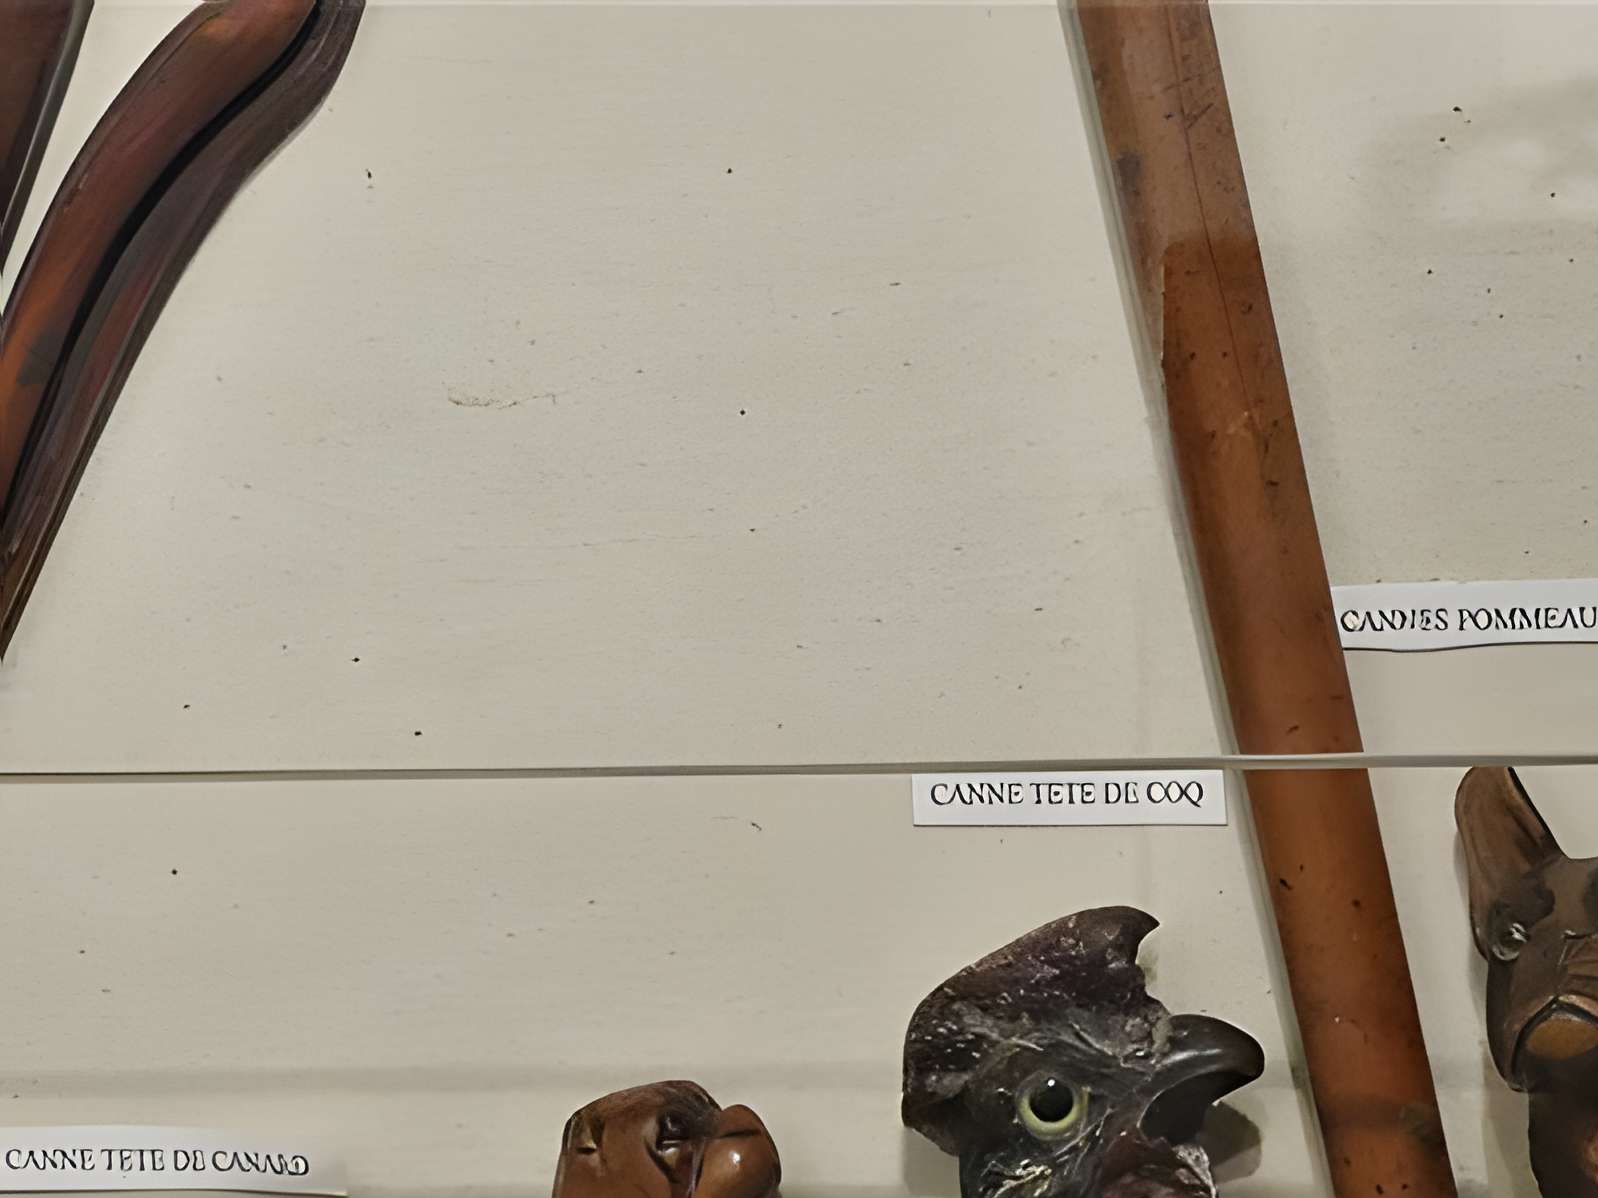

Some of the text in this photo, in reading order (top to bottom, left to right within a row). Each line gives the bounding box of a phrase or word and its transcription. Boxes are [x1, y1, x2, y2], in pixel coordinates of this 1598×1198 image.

[1457, 605, 1598, 632] POMMEAU
[930, 781, 1024, 806] CANNE
[1029, 782, 1096, 805] TETE
[1146, 780, 1204, 808] COQ
[5, 1148, 95, 1171] CANNE
[100, 1148, 165, 1171] TETE
